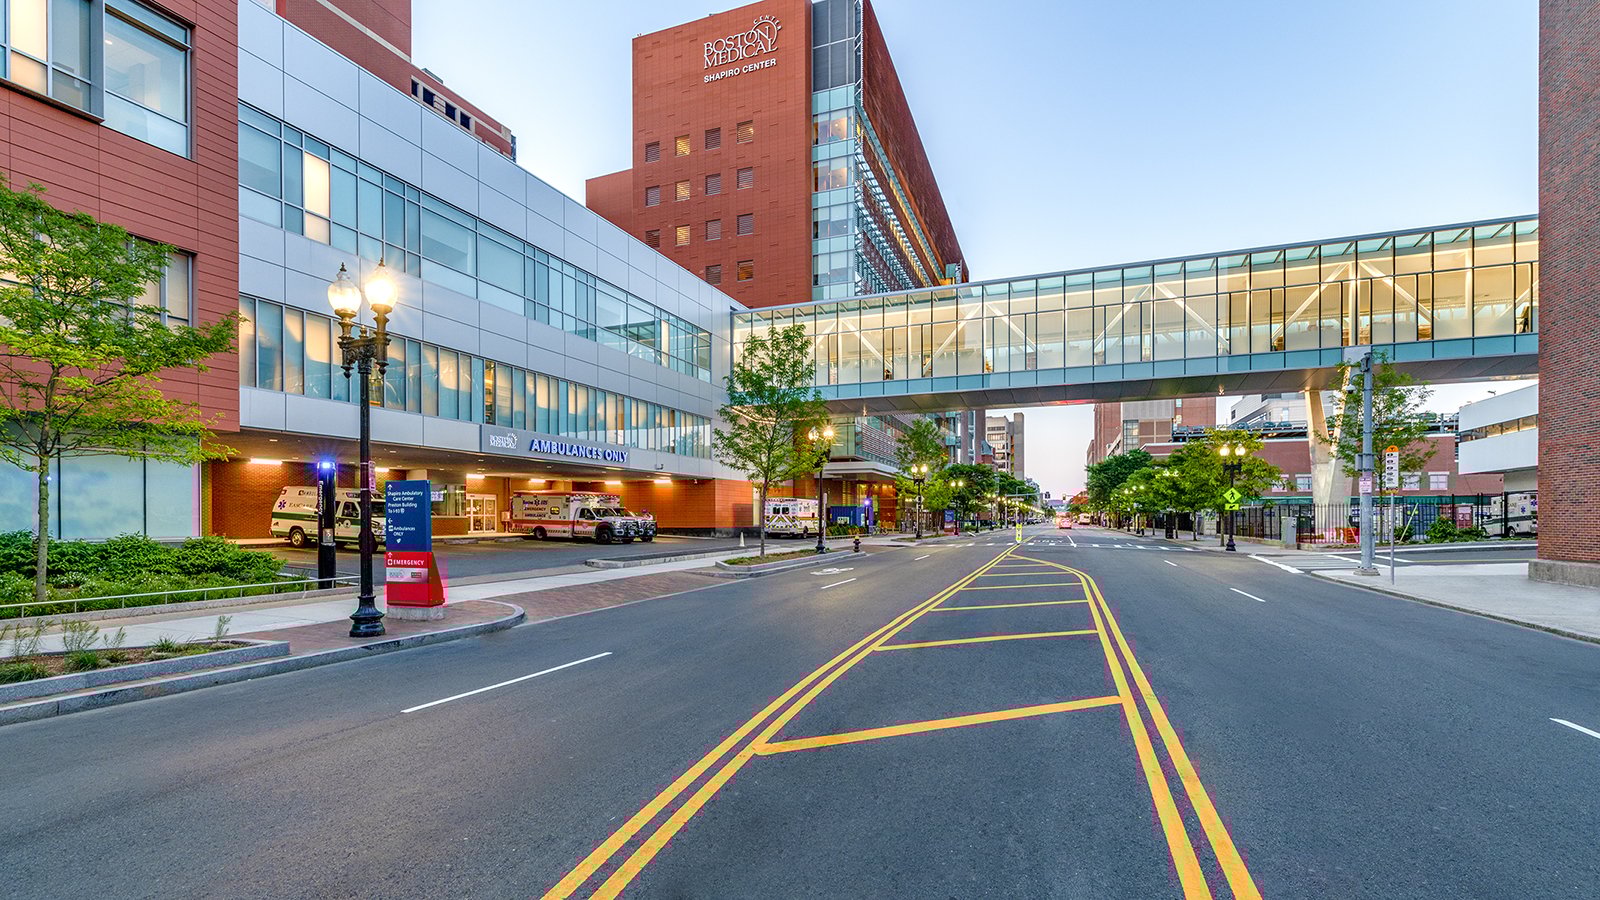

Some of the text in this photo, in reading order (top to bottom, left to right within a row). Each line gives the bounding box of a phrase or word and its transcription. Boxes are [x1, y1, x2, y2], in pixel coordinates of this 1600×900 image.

[753, 15, 782, 30] CENTER
[704, 26, 770, 56] BOSTON
[704, 39, 778, 69] MEDICAL
[704, 58, 777, 83] SHAPIRO CENTER
[489, 440, 517, 449] MEDICAL
[530, 439, 629, 462] AMBULANCES ONLY
